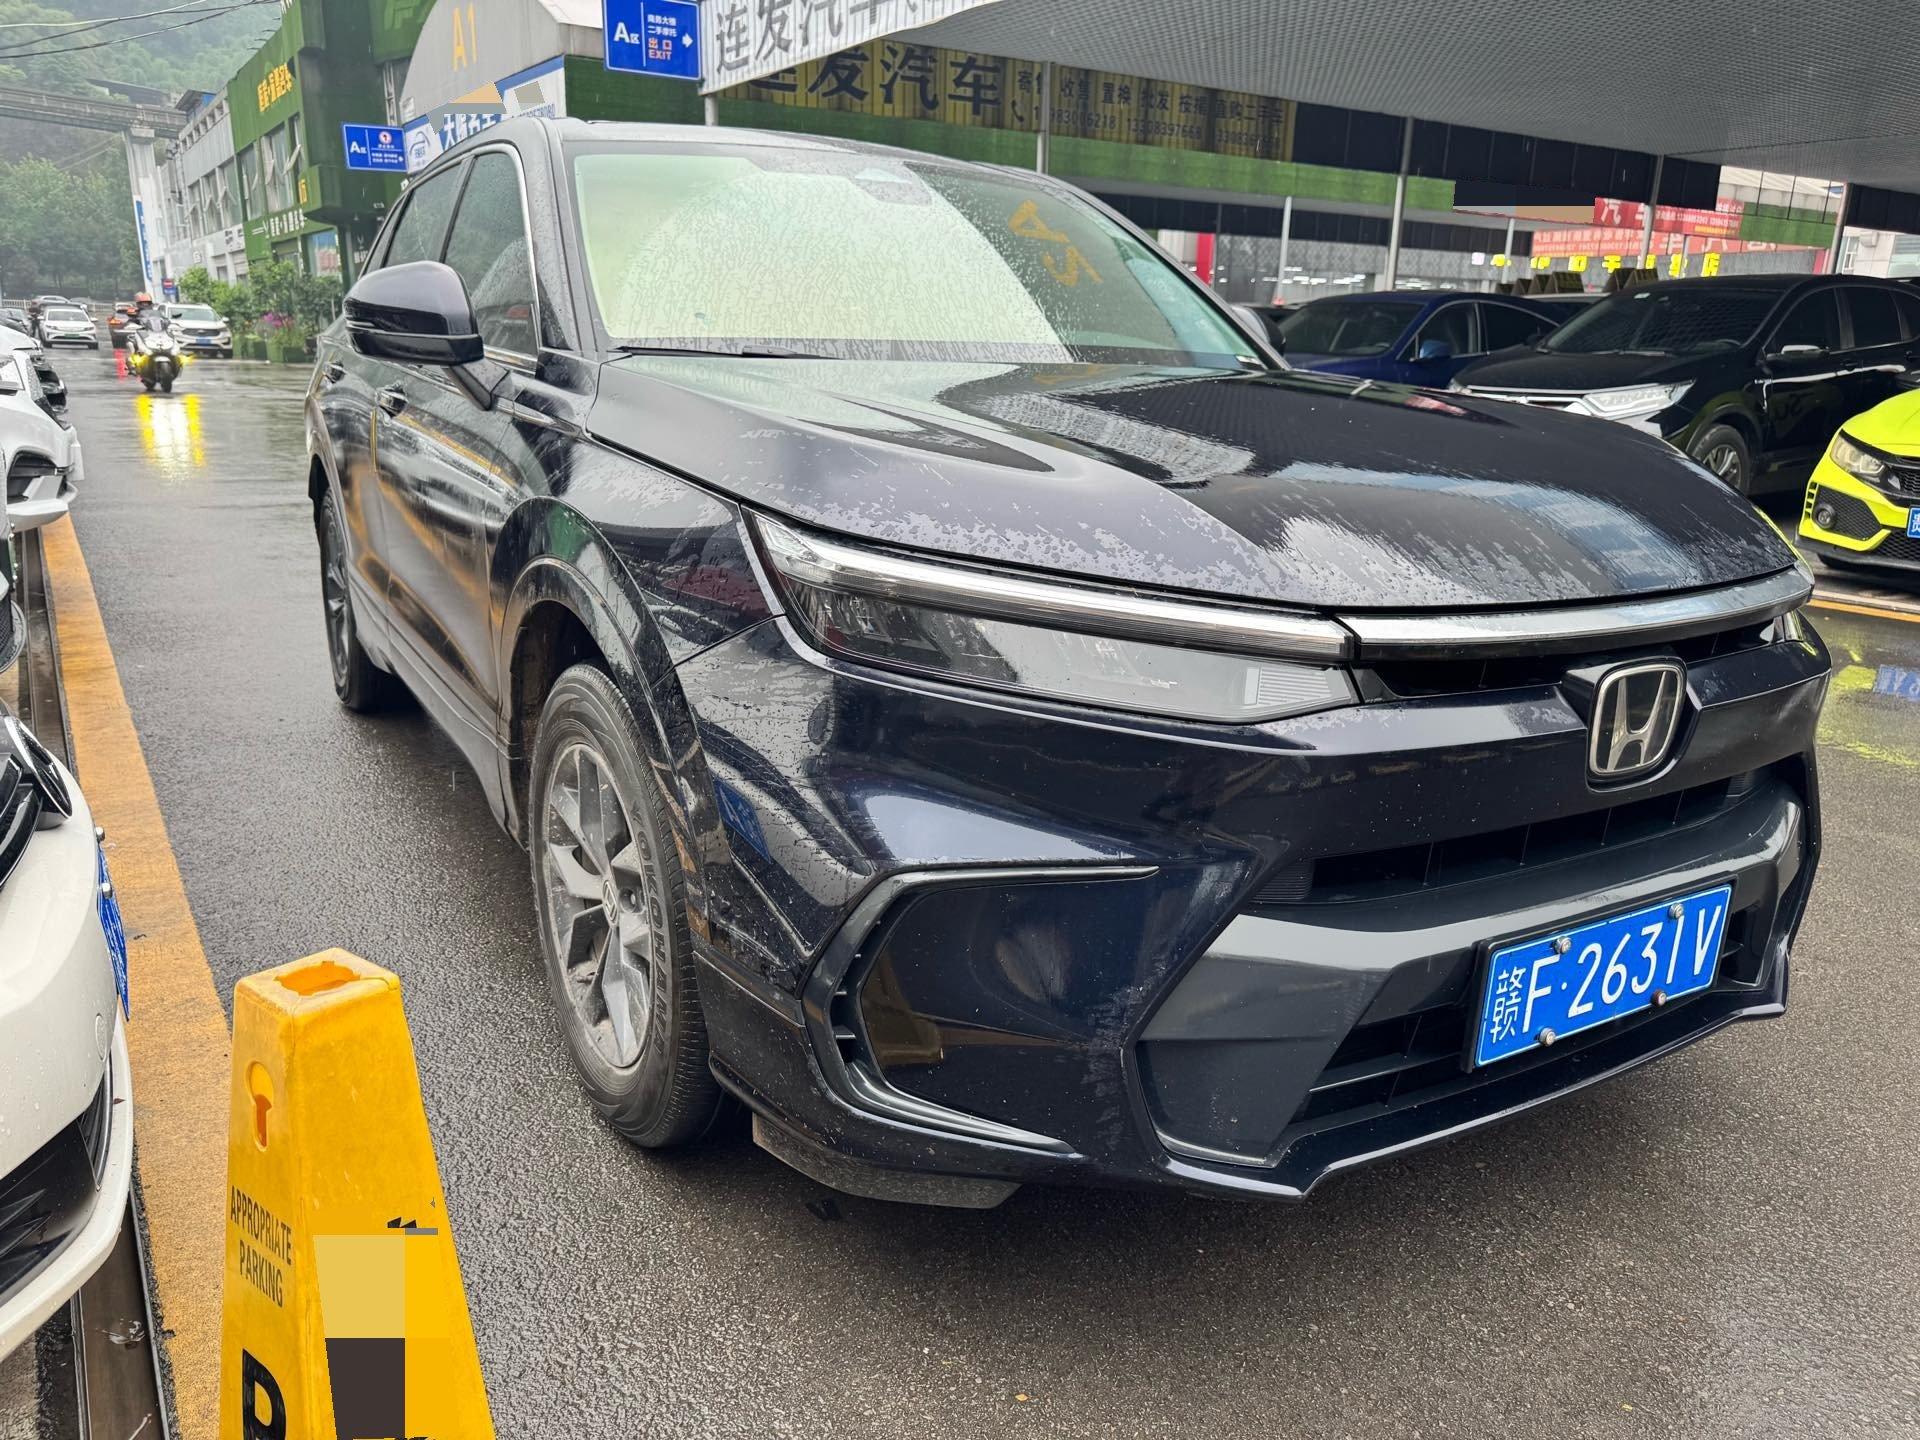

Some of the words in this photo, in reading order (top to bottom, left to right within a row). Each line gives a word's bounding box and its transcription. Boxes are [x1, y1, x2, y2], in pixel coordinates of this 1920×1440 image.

[452, 3, 478, 72] A1
[613, 21, 640, 45] A区
[648, 49, 672, 60] EXIT
[230, 1184, 292, 1266] APPROPRIATE
[239, 1239, 283, 1309] PARKING
